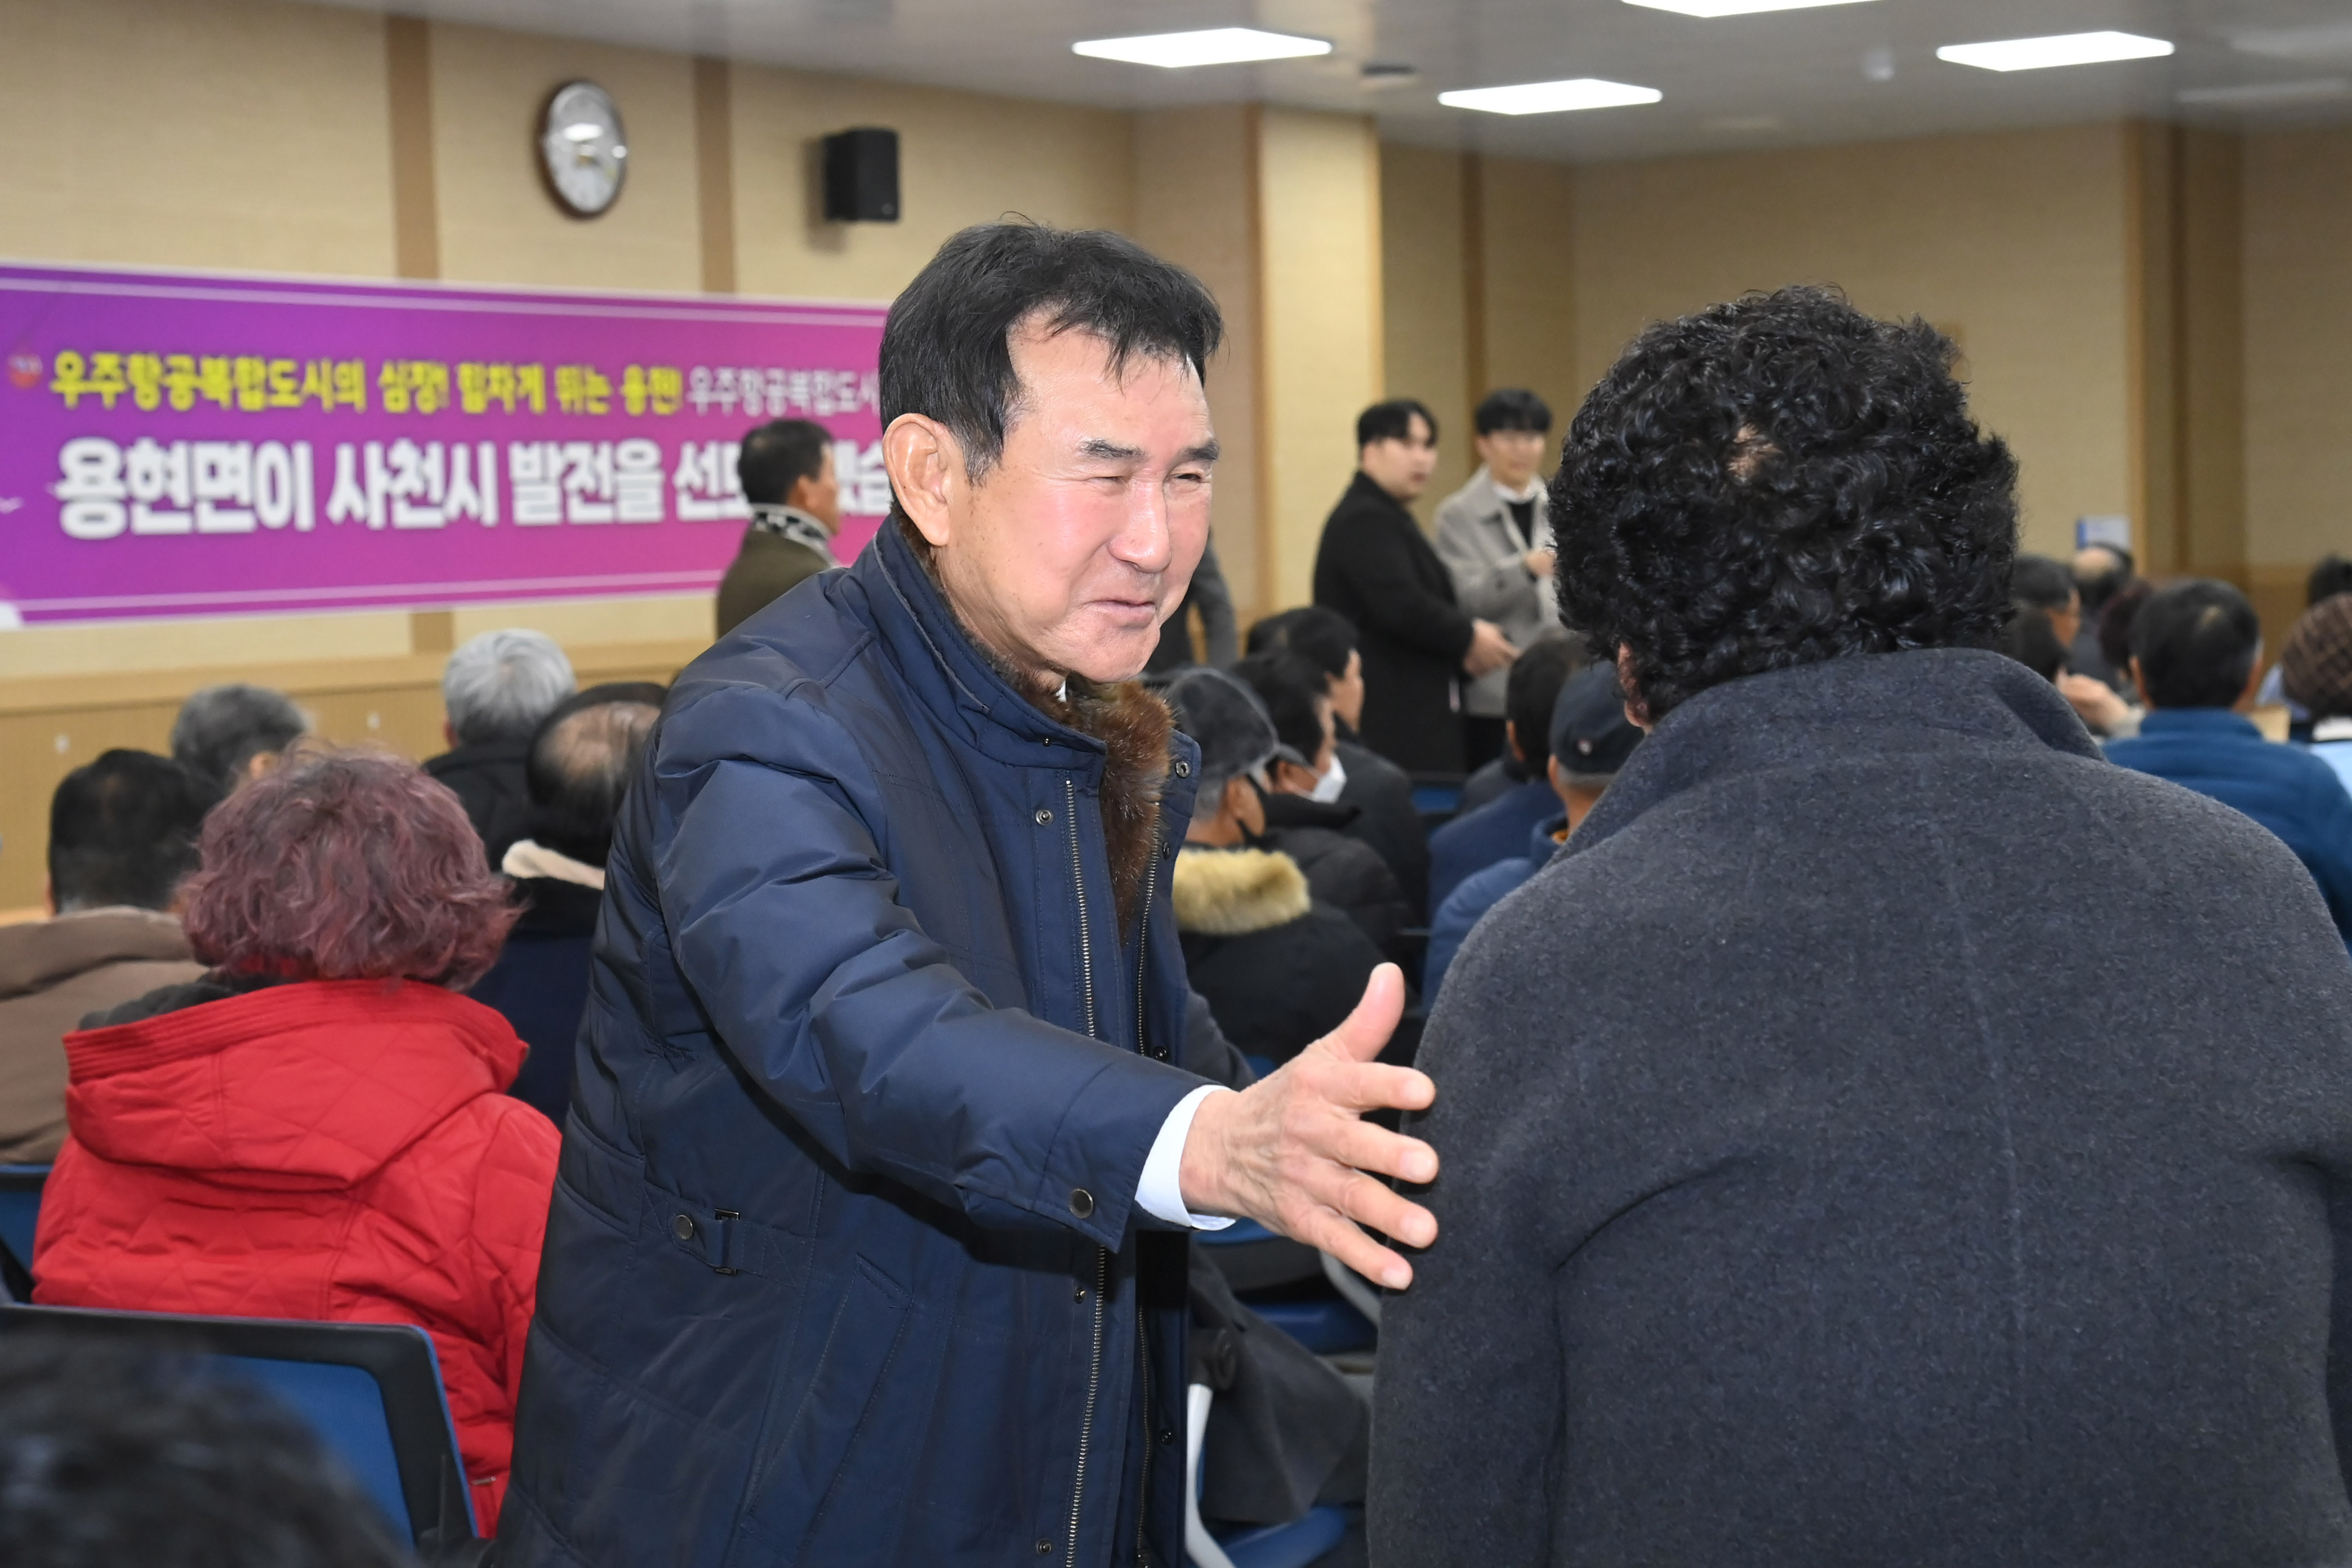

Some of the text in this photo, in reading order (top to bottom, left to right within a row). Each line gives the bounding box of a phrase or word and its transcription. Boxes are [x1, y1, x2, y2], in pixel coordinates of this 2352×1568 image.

[51, 350, 366, 411] 우주항공복합도시의
[457, 363, 545, 413] 힘차게
[556, 365, 611, 414] 뛰는
[55, 437, 315, 540] 용현면이
[326, 437, 499, 529] 사천시
[508, 438, 665, 525] 발전을
